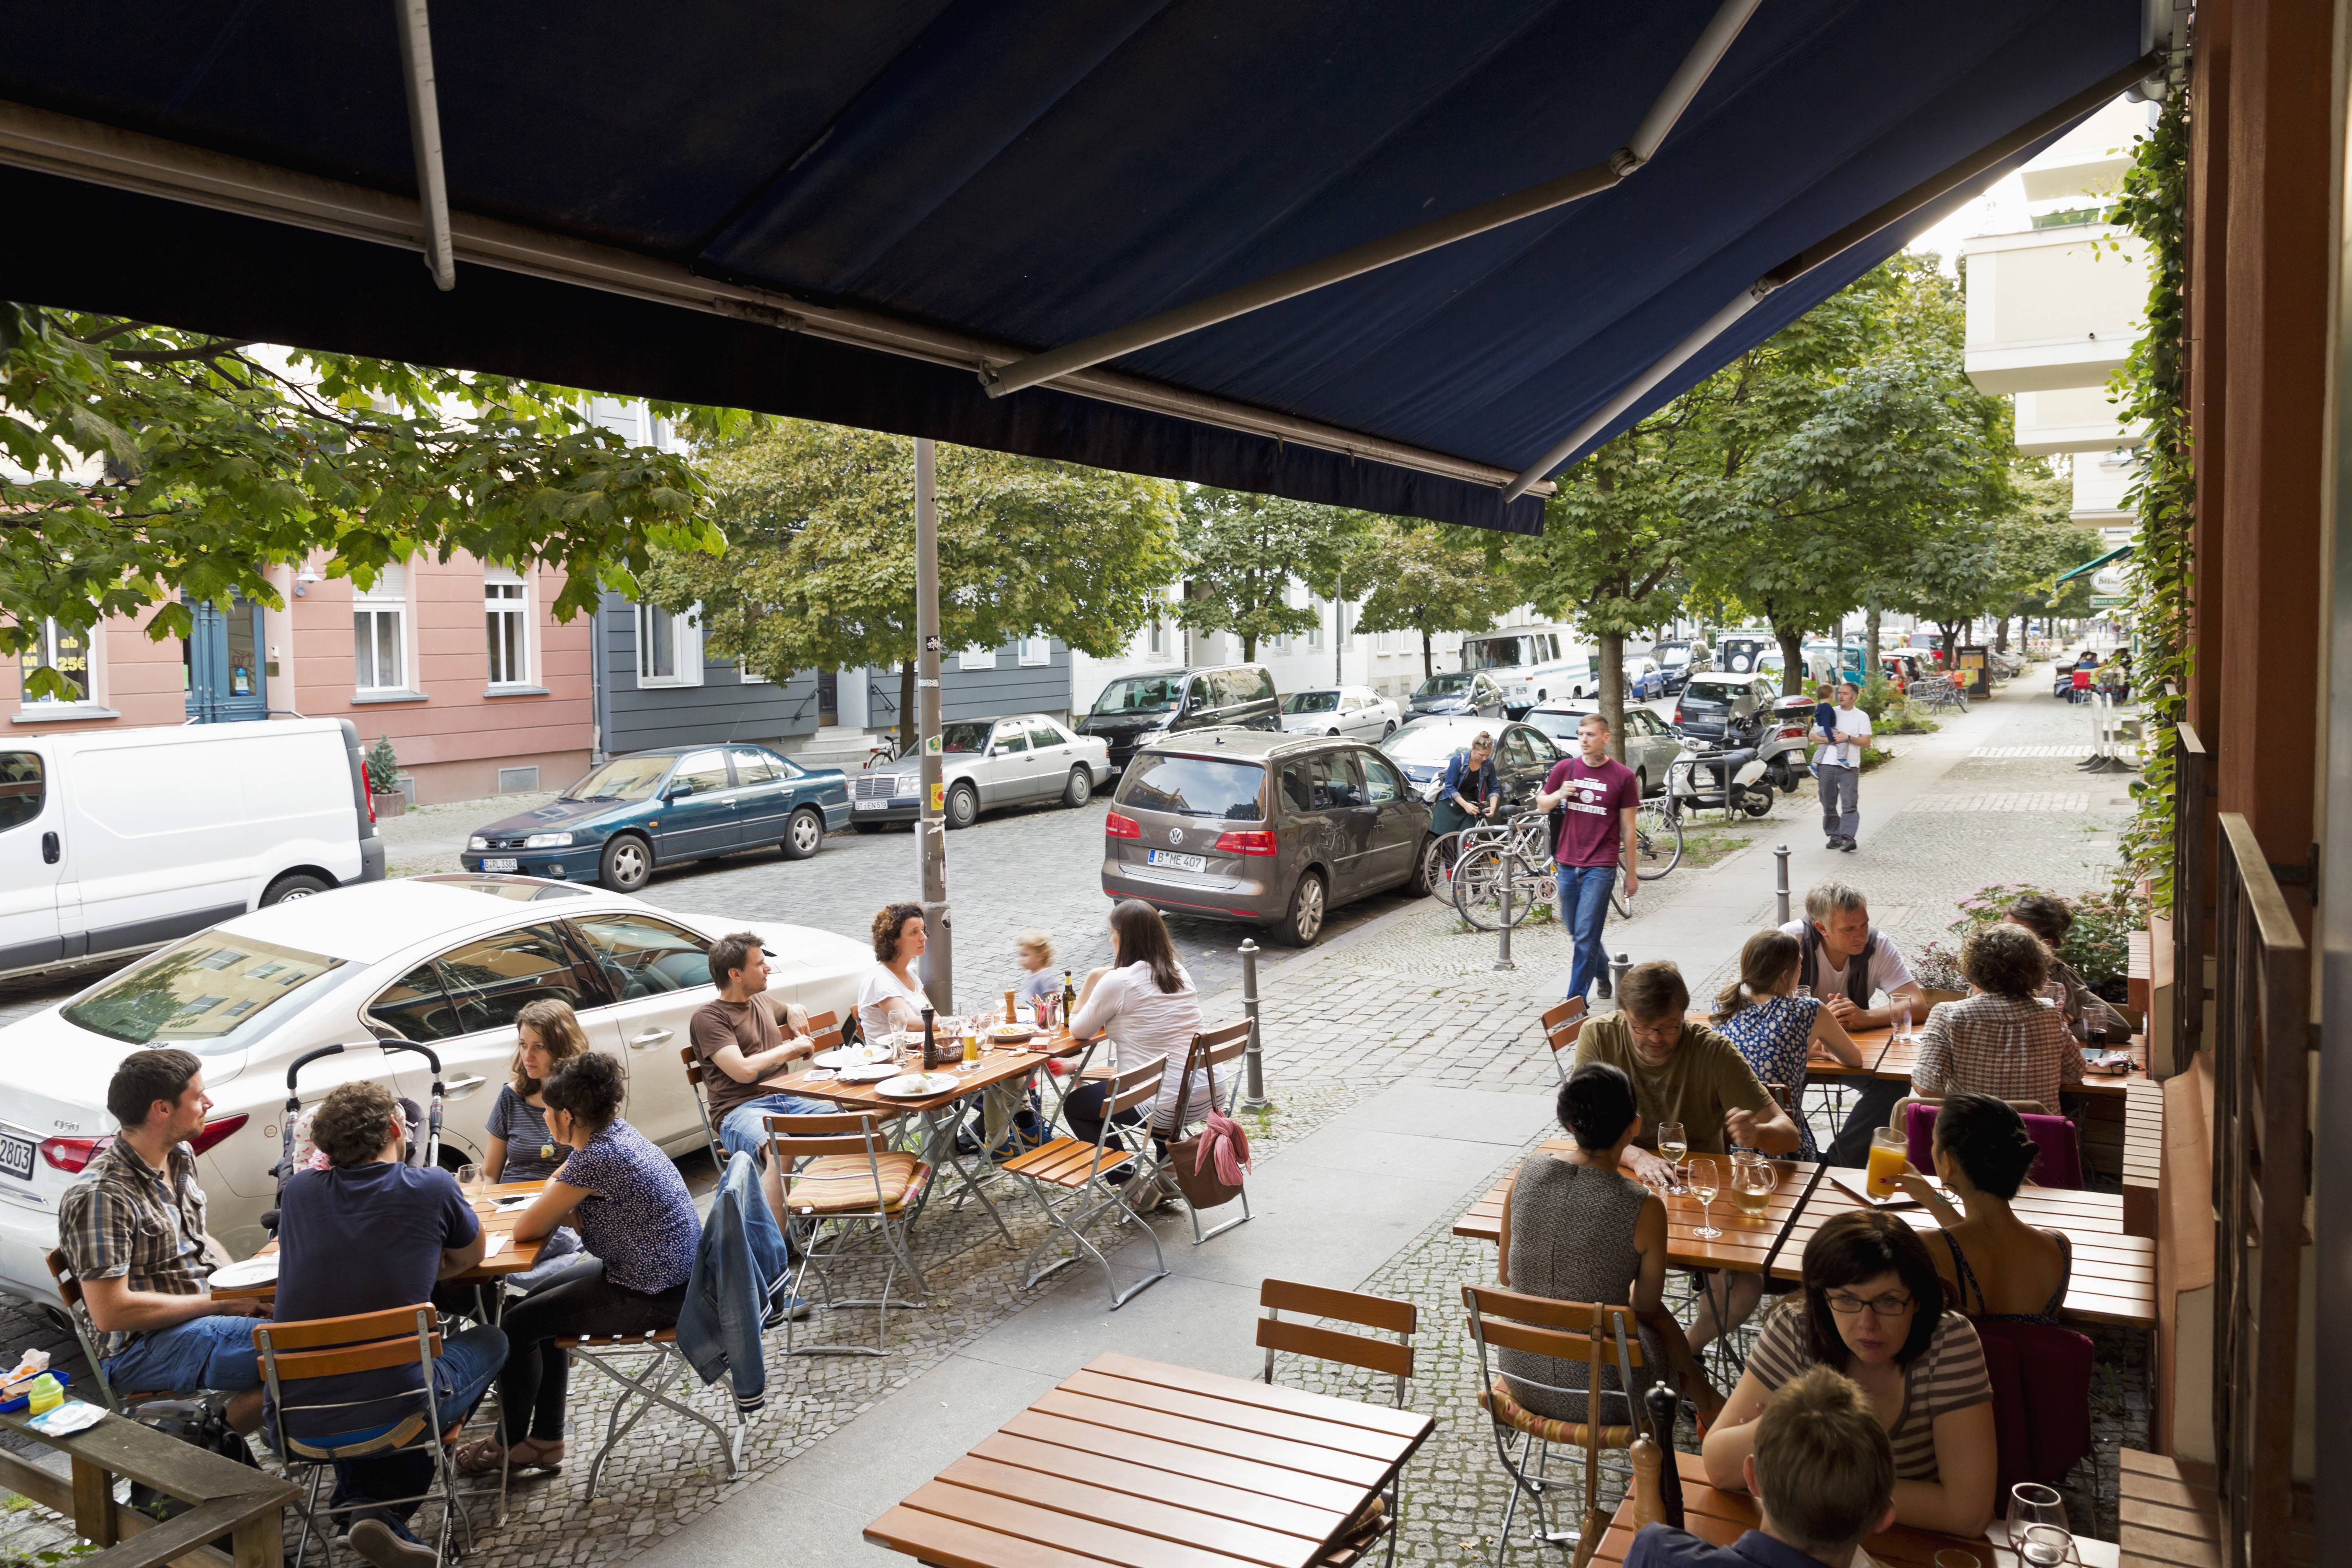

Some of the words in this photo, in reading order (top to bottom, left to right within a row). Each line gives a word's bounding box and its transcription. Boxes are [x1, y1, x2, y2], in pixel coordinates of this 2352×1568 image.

[60, 636, 78, 648] ab
[57, 657, 86, 671] 25€
[501, 860, 516, 868] 3382
[1158, 852, 1164, 862] B
[1169, 854, 1182, 865] ME
[1183, 857, 1202, 868] 407
[54, 1119, 79, 1132] Q50
[0, 1139, 30, 1169] 2803
